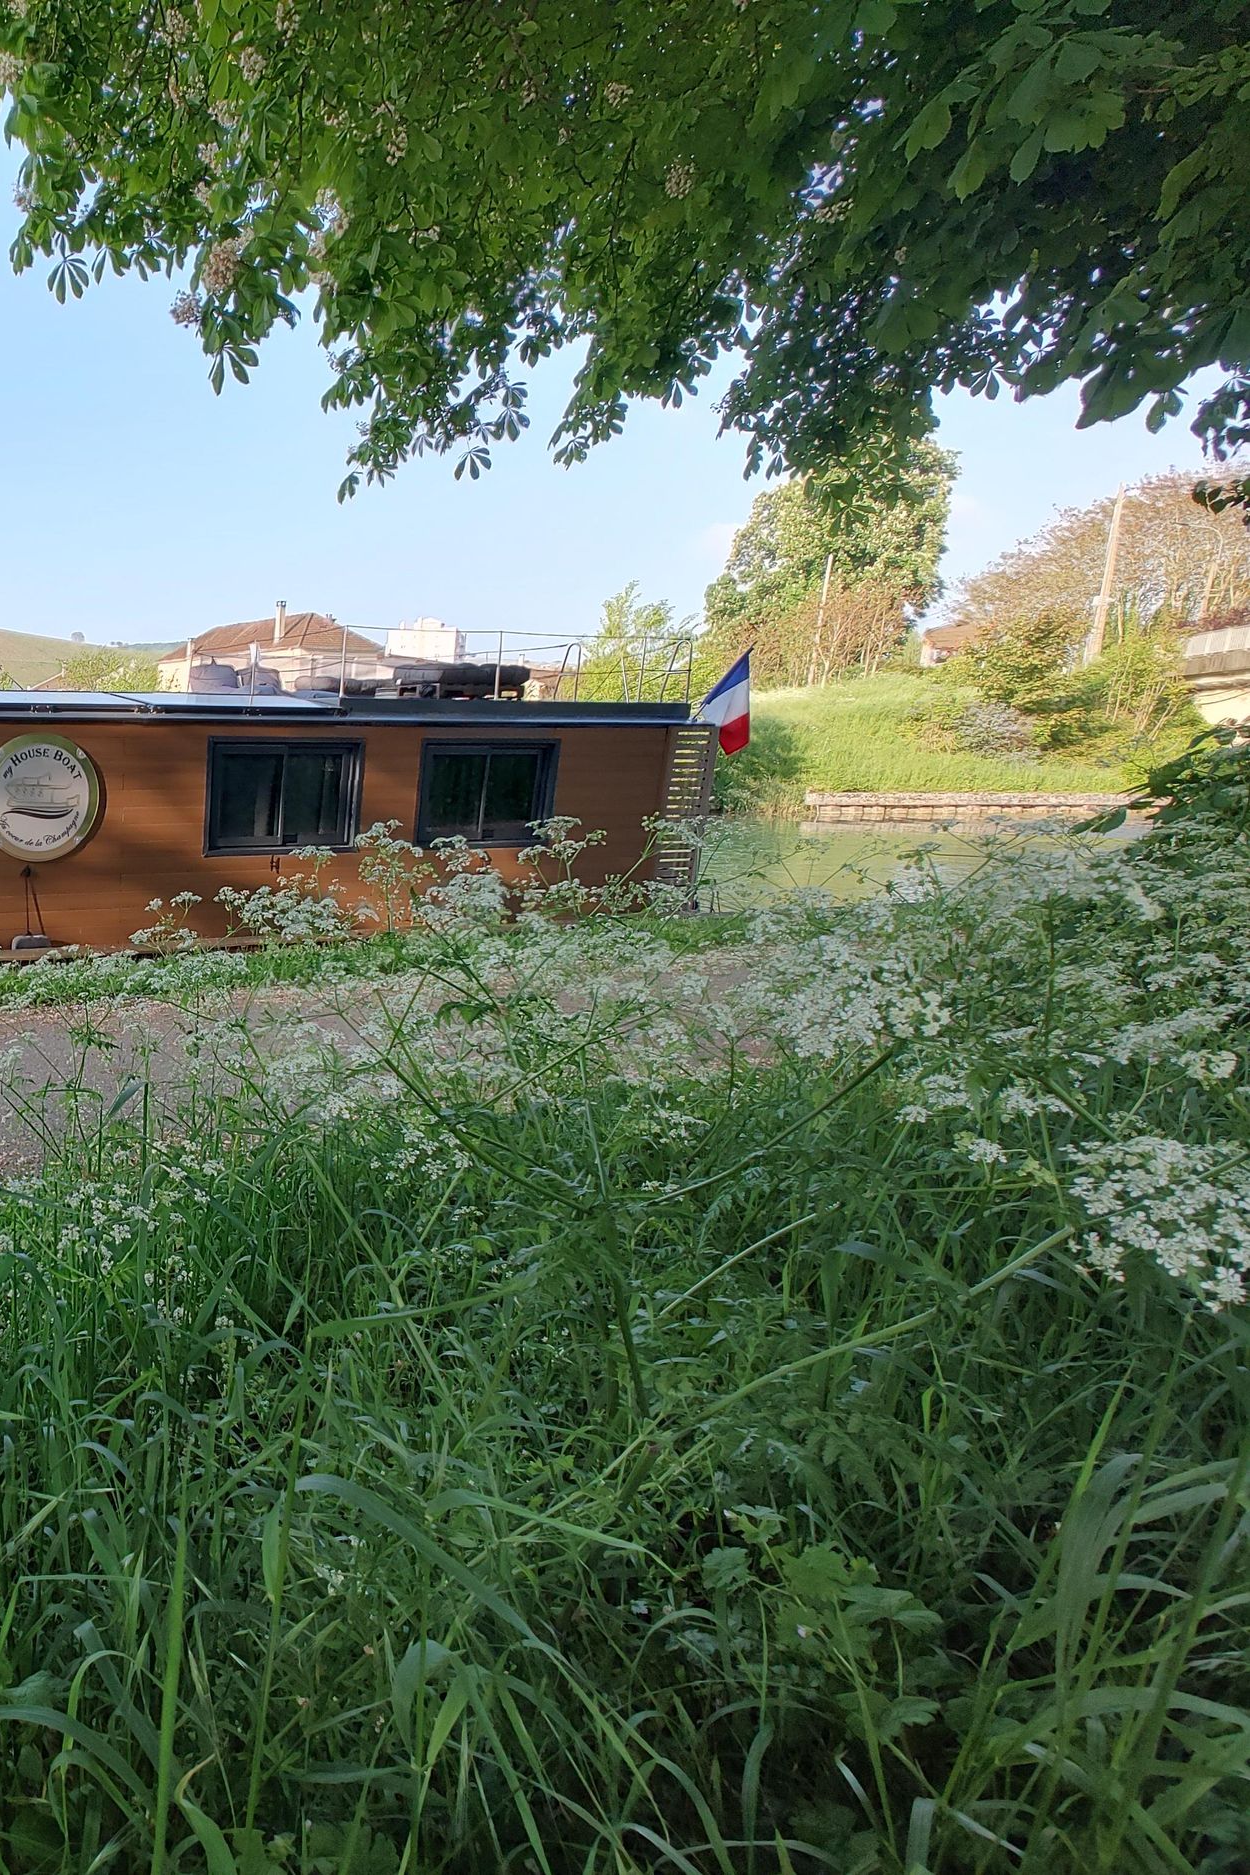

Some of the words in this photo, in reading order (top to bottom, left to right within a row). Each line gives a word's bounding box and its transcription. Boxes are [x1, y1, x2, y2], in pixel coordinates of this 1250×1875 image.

[2, 766, 14, 779] my
[10, 748, 50, 767] HOUSE
[53, 750, 82, 779] BOAT
[24, 838, 34, 847] de
[35, 838, 43, 847] la
[44, 810, 80, 846] Champagne
